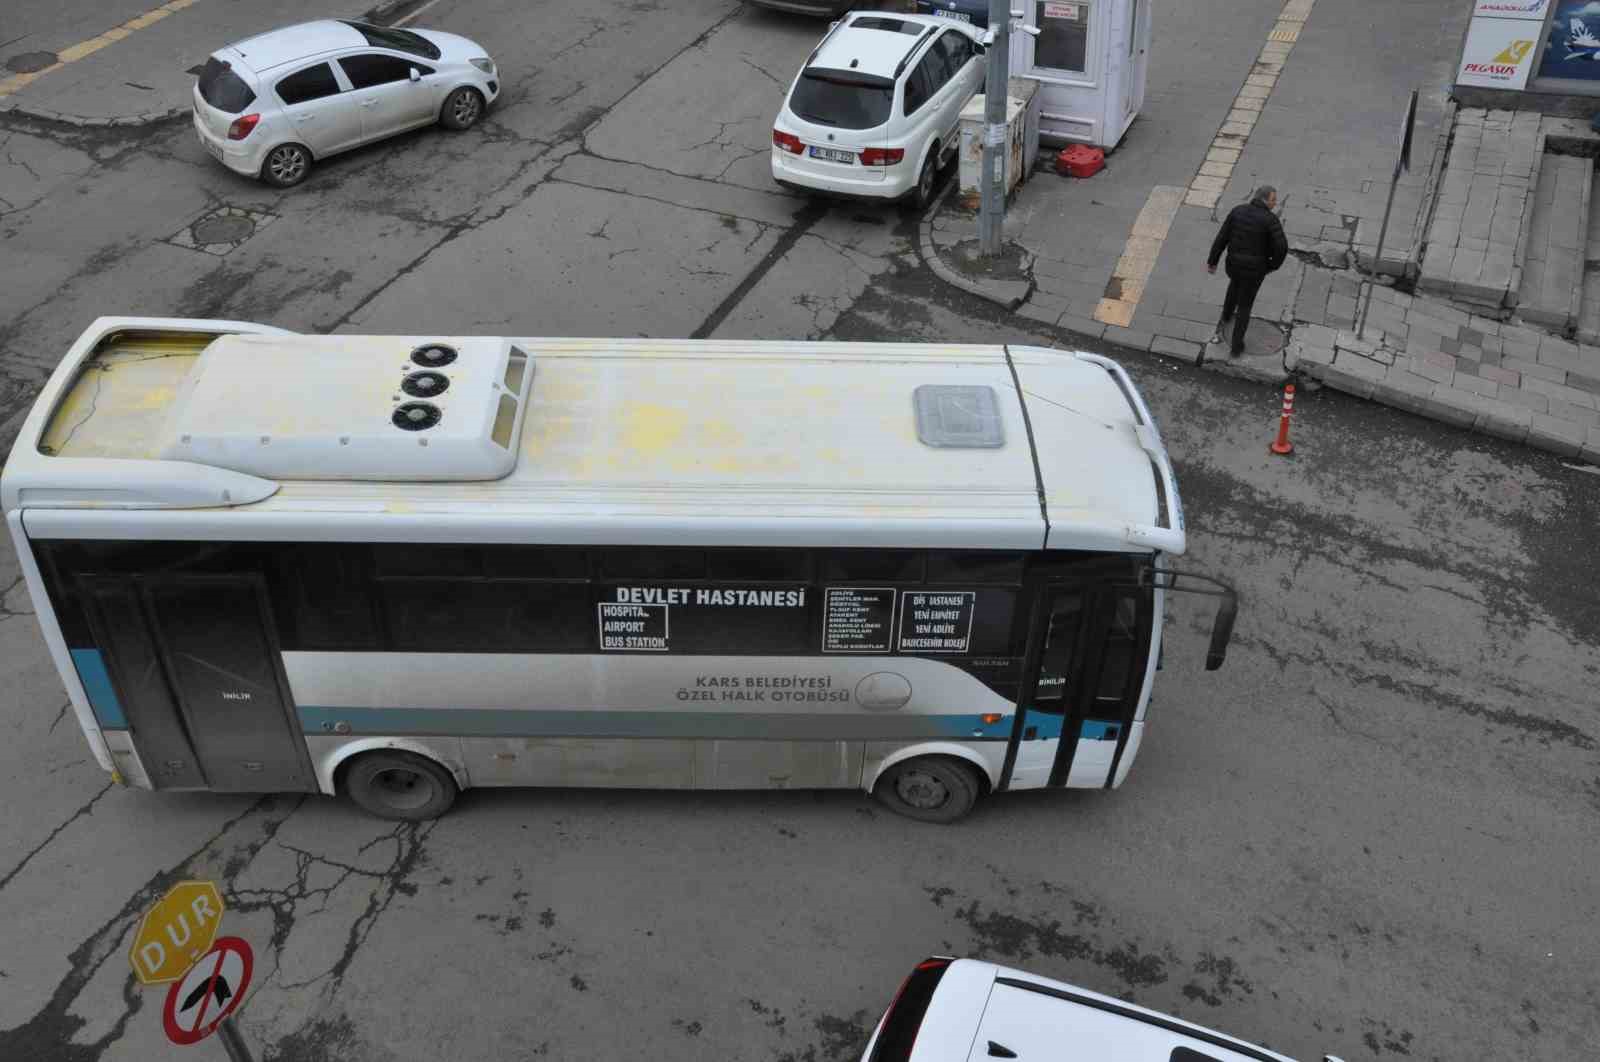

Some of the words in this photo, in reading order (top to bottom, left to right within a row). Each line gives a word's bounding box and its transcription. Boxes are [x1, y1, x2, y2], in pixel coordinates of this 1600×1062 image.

[1464, 63, 1516, 76] PEGASUS
[616, 587, 691, 604] DEVLET
[696, 588, 805, 607] HASTANESİ
[914, 609, 930, 620] YENİ
[604, 621, 645, 633] AIRPORT
[915, 623, 931, 634] YENİ
[605, 636, 625, 648] BUS
[626, 637, 666, 648] STATION
[695, 677, 740, 688] KARS
[745, 675, 832, 689] BELEDİYESİ
[676, 689, 717, 702] ÖZEL
[722, 690, 765, 702] HALK
[770, 689, 850, 703] OTOBÜSÜ
[140, 895, 215, 975] DUR
